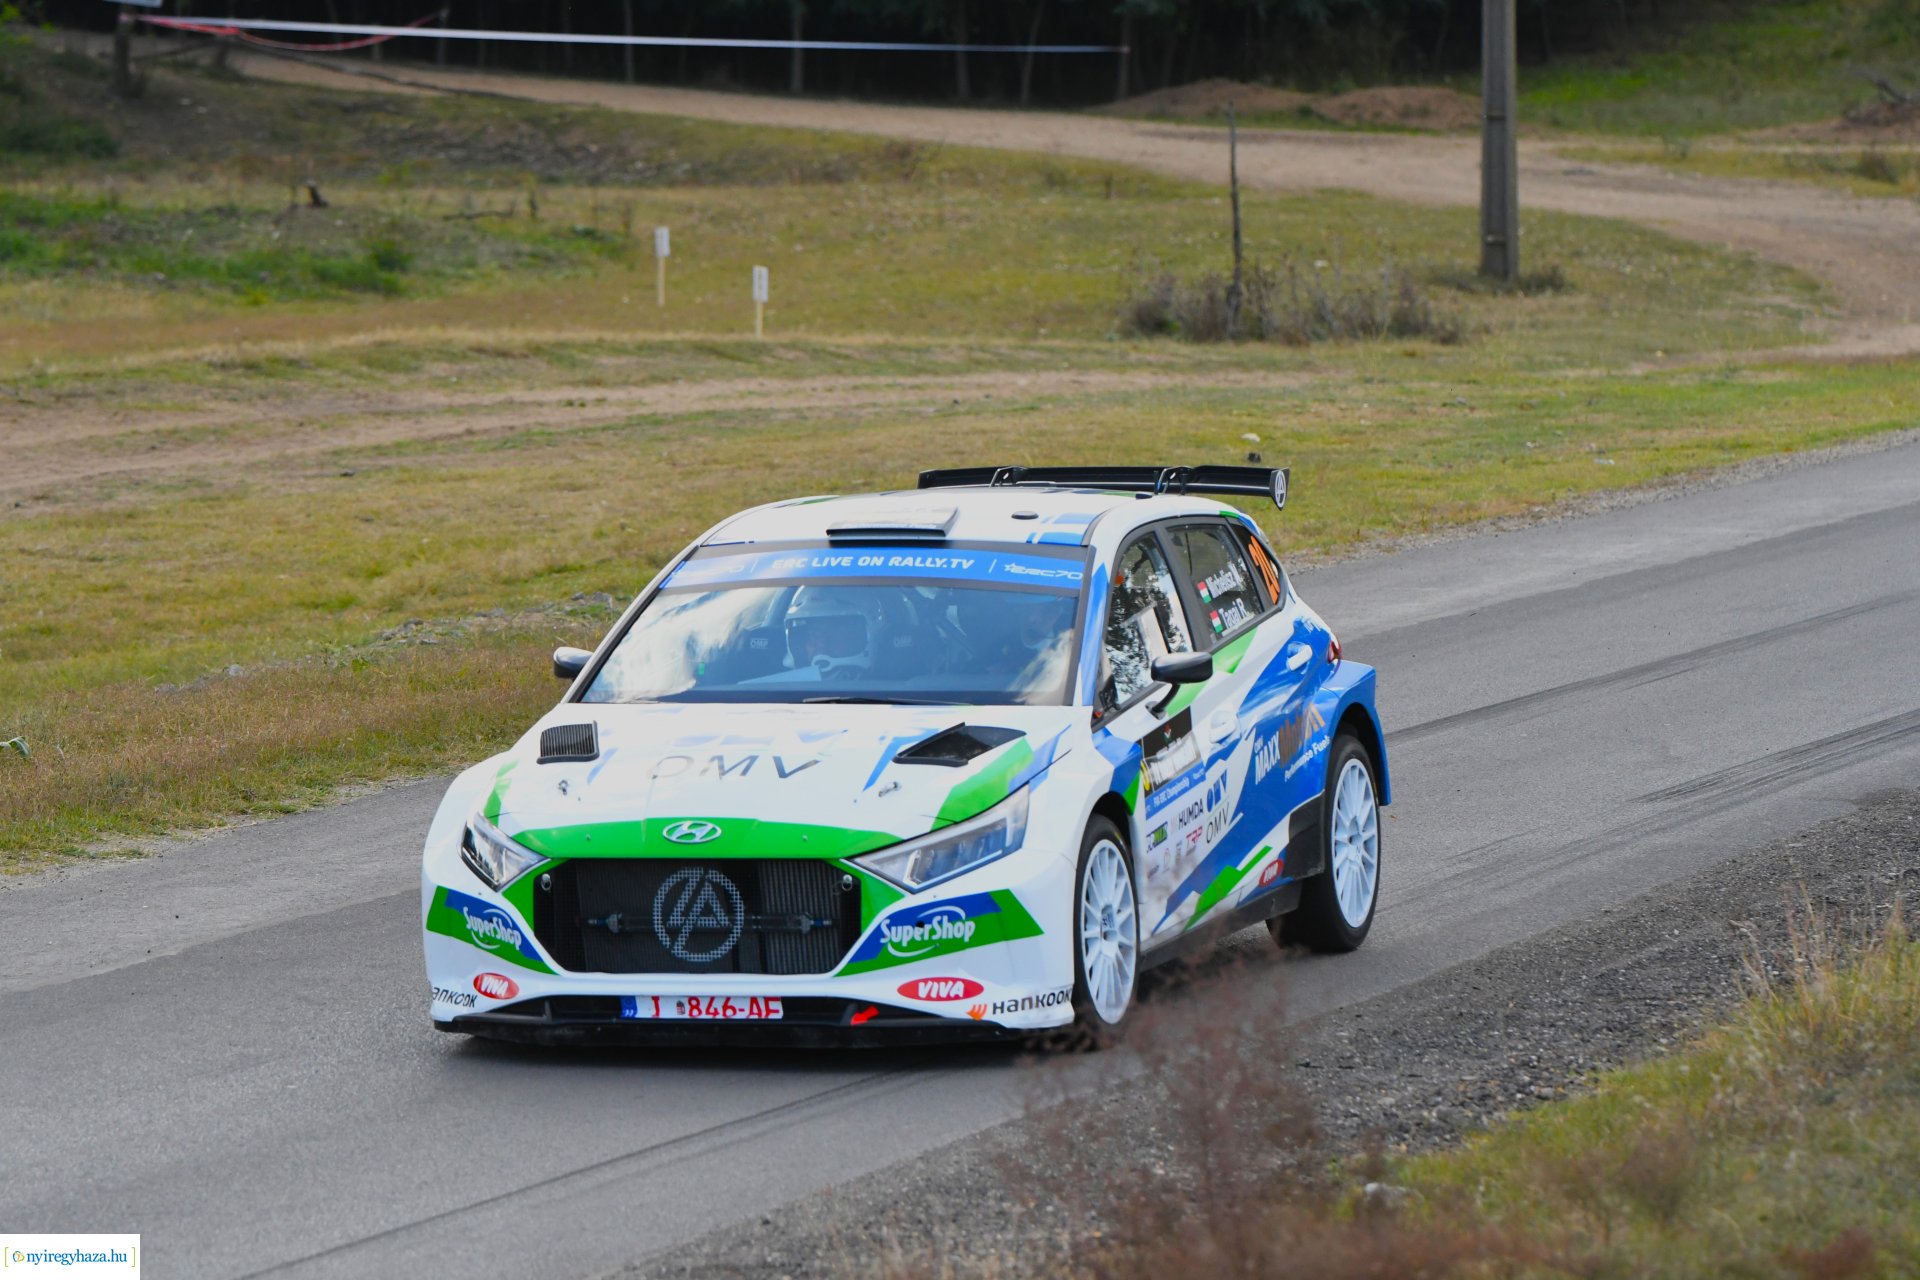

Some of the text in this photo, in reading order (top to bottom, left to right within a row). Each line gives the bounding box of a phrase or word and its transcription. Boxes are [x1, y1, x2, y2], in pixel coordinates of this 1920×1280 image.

[772, 556, 975, 570] ERC LIVE ON RALLY.TV
[646, 755, 822, 780] OMV
[1178, 798, 1204, 830] HUMDA
[1206, 801, 1230, 844] OMV
[463, 906, 522, 950] SuperShop
[880, 915, 976, 947] SuperShop
[481, 976, 509, 997] VIVA
[918, 980, 965, 998] VIVA
